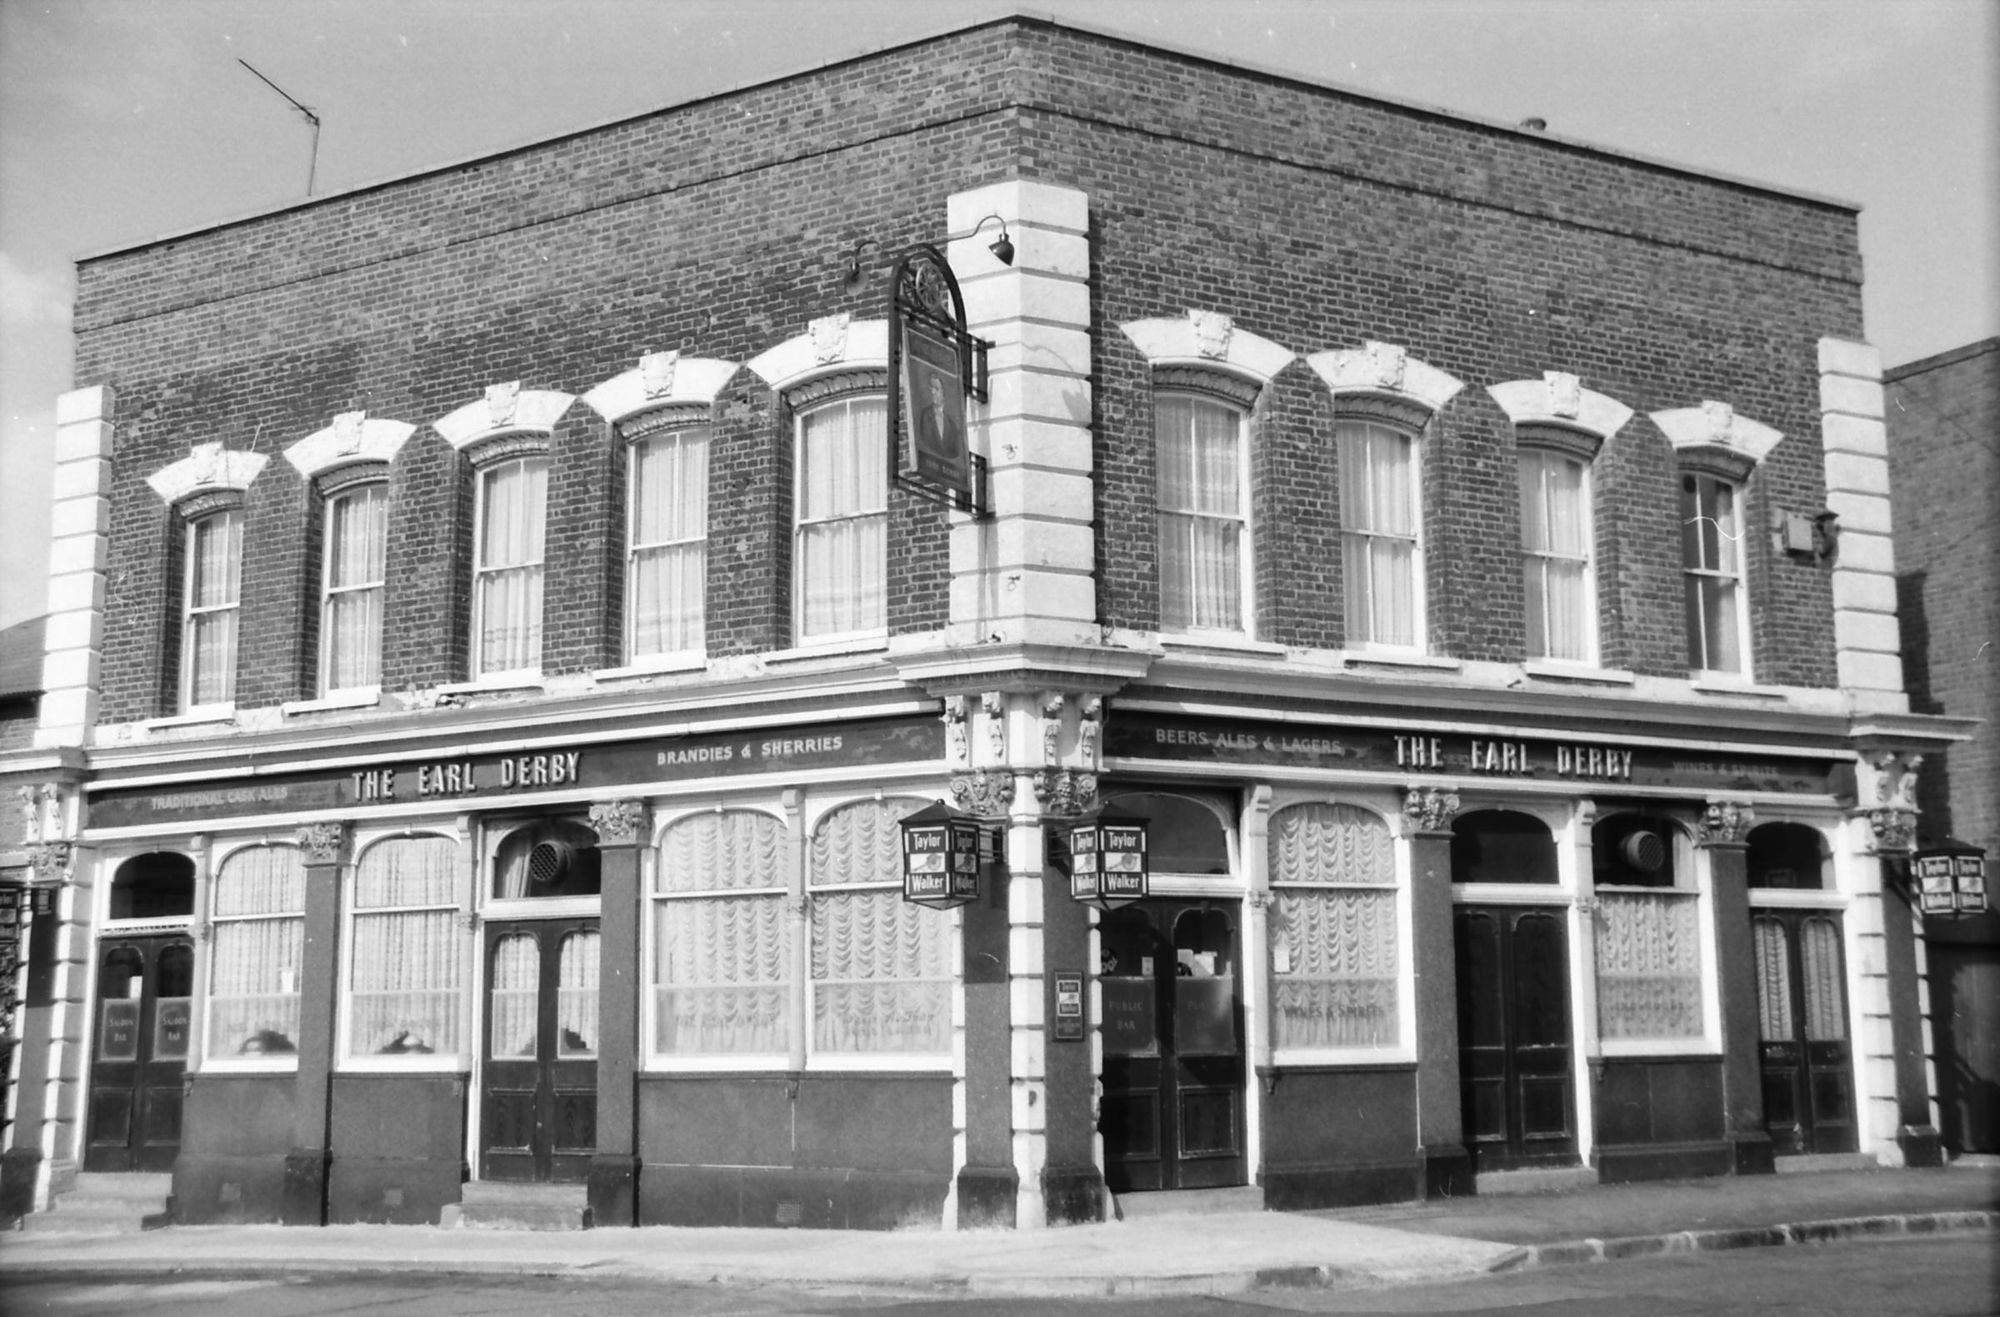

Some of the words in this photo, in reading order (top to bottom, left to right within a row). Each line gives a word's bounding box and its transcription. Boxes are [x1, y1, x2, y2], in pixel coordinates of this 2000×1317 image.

[657, 746, 733, 766] BRANDIES
[741, 745, 751, 759] &
[761, 736, 843, 757] SHERRIES
[1156, 728, 1208, 745] BEERS
[1215, 733, 1258, 749] ALES
[1263, 736, 1274, 750] &
[1282, 737, 1342, 754] LAGERS
[1394, 735, 1444, 767] THE
[1471, 740, 1533, 772] EARL
[1557, 745, 1633, 778] DERBY
[1672, 760, 1714, 774] WINES
[352, 769, 395, 799] THE
[418, 762, 476, 794] EARL
[501, 752, 580, 788] DERBY
[152, 791, 225, 810] TRADITIONAL
[227, 787, 256, 803] CASK
[258, 786, 288, 801] ALES
[913, 832, 942, 851] Taylor
[1108, 831, 1137, 850] Taylor
[911, 874, 945, 892] Walker
[1107, 873, 1140, 891] Walker
